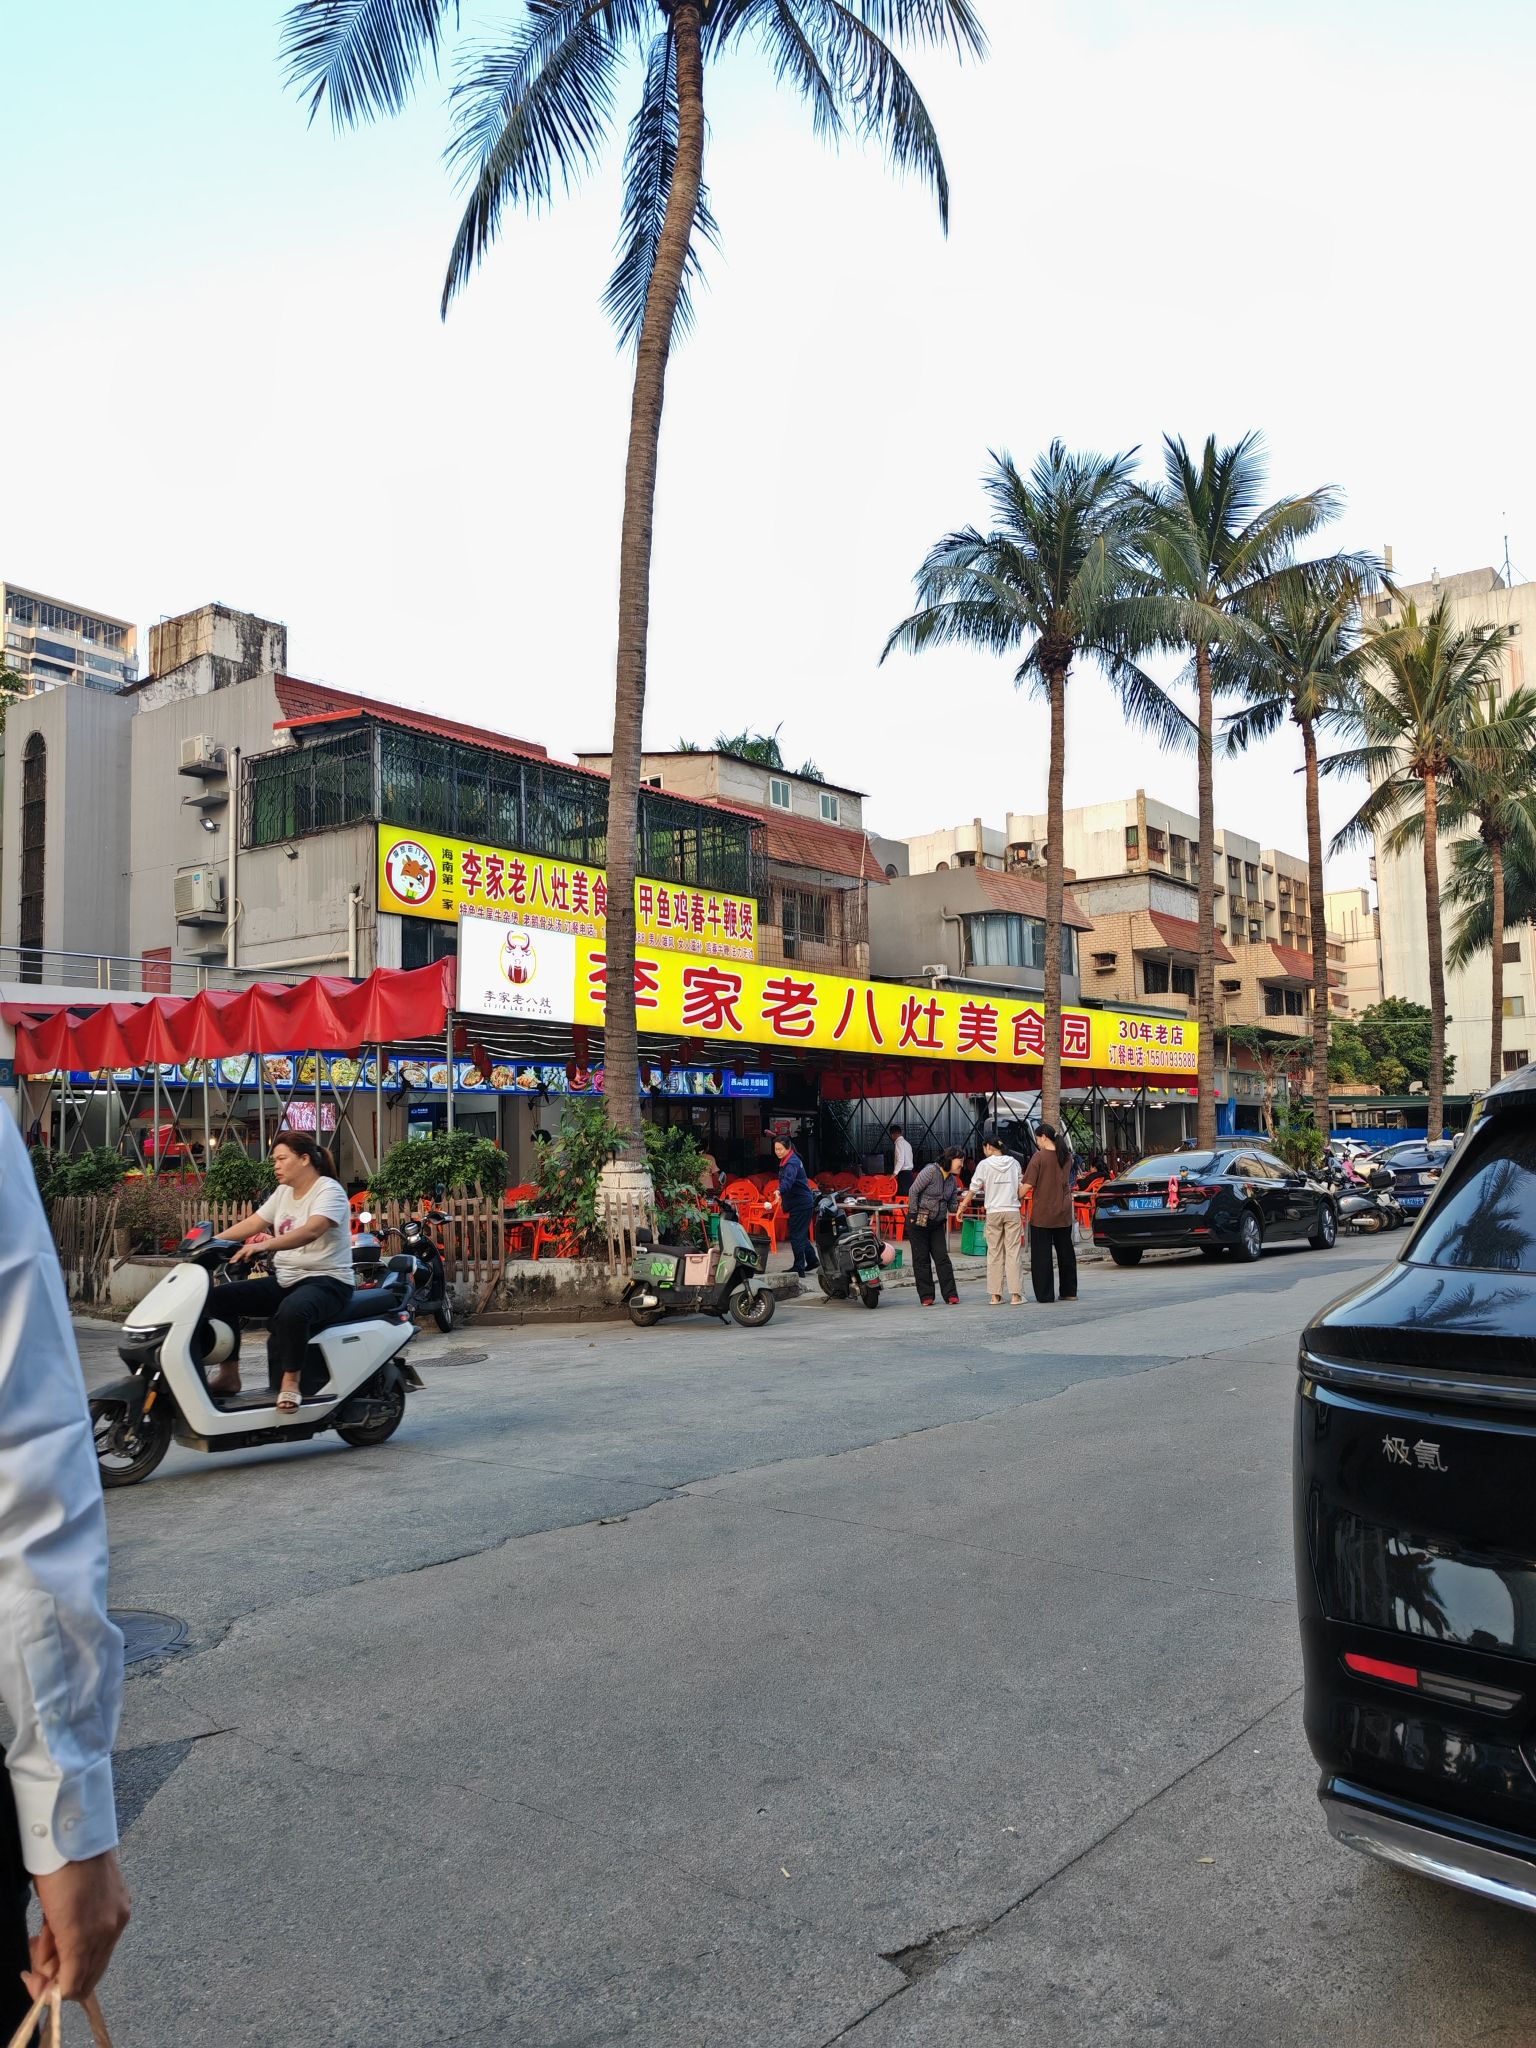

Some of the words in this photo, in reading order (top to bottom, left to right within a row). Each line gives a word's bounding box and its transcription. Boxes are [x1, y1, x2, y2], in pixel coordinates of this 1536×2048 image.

[442, 848, 454, 910] 海南第一家
[484, 990, 551, 1008] 李家老八灶
[1119, 1020, 1183, 1045] 30年老店
[1382, 1433, 1448, 1472] 极氪
